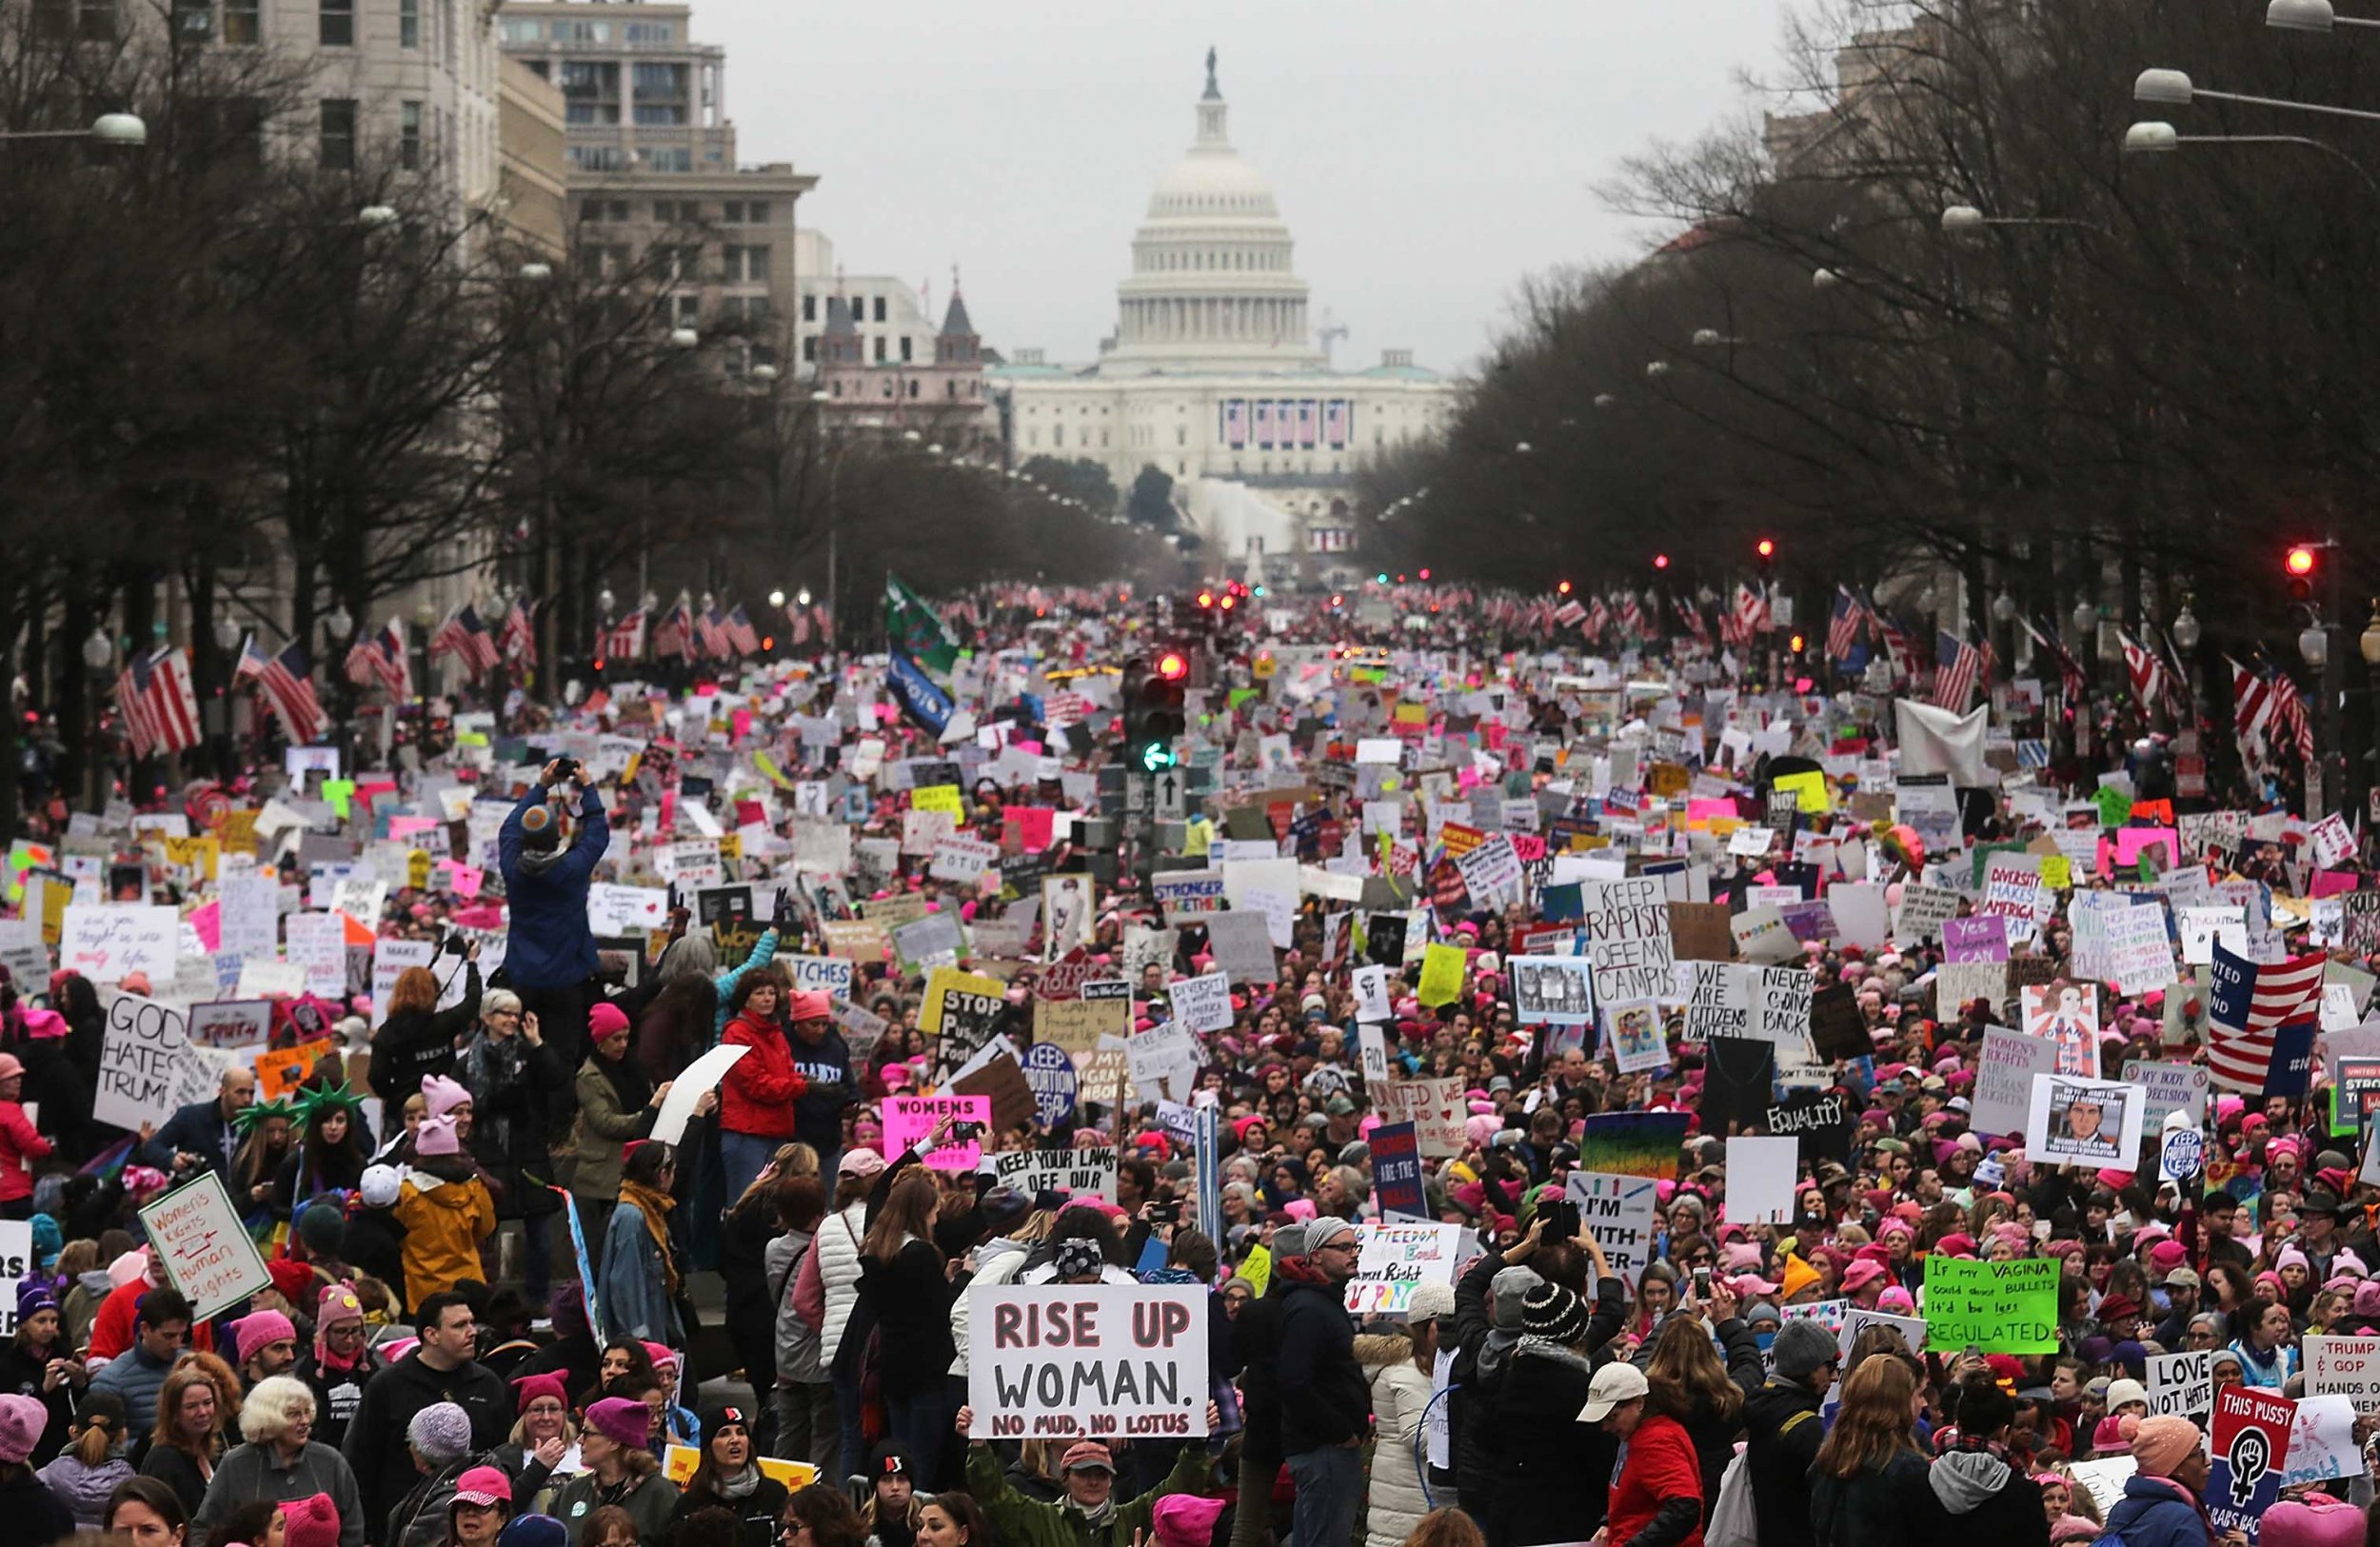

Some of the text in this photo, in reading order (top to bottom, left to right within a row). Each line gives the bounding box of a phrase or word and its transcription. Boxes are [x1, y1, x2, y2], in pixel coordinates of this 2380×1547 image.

[1770, 794, 1795, 810] NO!
[1991, 867, 2041, 888] DIVERSITY
[1154, 881, 1223, 899] STRONGER
[1600, 881, 1655, 909] KEEP
[1991, 884, 2035, 902] MAKES
[1985, 900, 2034, 921] AMERICA
[1586, 904, 1670, 941] RAPISTS
[1955, 921, 1988, 937] Yes
[1596, 938, 1671, 971] OFF MY
[1598, 966, 1676, 1001] CAMPUS
[1696, 962, 1729, 987] WE
[1763, 968, 1813, 993] NEVER
[944, 990, 1003, 1017] STOP
[1692, 987, 1725, 1006] ARE
[110, 997, 186, 1049] GOD
[1691, 1006, 1747, 1027] CITIZENS
[1763, 1010, 1805, 1039] BACK
[1987, 1034, 2038, 1057] WOMEN'S
[1028, 1045, 1066, 1068] KEEP
[1096, 1053, 1124, 1067] MY
[1985, 1049, 2029, 1068] RIGHTS
[1984, 1062, 2005, 1075] ARE
[2142, 1070, 2187, 1085] MY BODY
[1981, 1074, 2026, 1092] HUMAN
[2345, 1079, 2380, 1091] STRO
[1370, 1081, 1464, 1107] UNITED WE
[1980, 1089, 2024, 1106] RIGHTS
[2146, 1087, 2193, 1103] DECISION
[897, 1101, 974, 1115] WOMENS
[1034, 1093, 1070, 1120] EGAL
[1766, 1095, 1842, 1134] EQUALITY
[2054, 1137, 2077, 1145] BECAUSE
[2174, 1132, 2197, 1145] KEEP
[996, 1152, 1033, 1177] KEEP
[1035, 1150, 1074, 1170] YOUR
[1027, 1170, 1101, 1193] OFF OUR
[152, 1193, 209, 1232] Women's
[1585, 1197, 1620, 1218] I'M
[177, 1244, 234, 1282] Human
[1603, 1253, 1632, 1271] ER
[1991, 1262, 2051, 1279] VAGINA
[191, 1266, 243, 1299] Rights
[2005, 1279, 2055, 1295] BULLETS
[1968, 1301, 1982, 1313] be
[994, 1301, 1191, 1349] RISE UP
[2326, 1342, 2375, 1355] TRUMP
[2157, 1353, 2210, 1386] LOVE
[2334, 1360, 2365, 1372] GOP
[994, 1359, 1193, 1408] WOMAN.
[2316, 1382, 2364, 1394] HANDS
[2149, 1382, 2211, 1417] NOT HATE
[2351, 1400, 2380, 1413] MEN
[2224, 1394, 2293, 1427] THIS PUSSY
[991, 1413, 1191, 1438] NO MUD, NO LOTUS
[2208, 1507, 2261, 1536] RABS BAC
